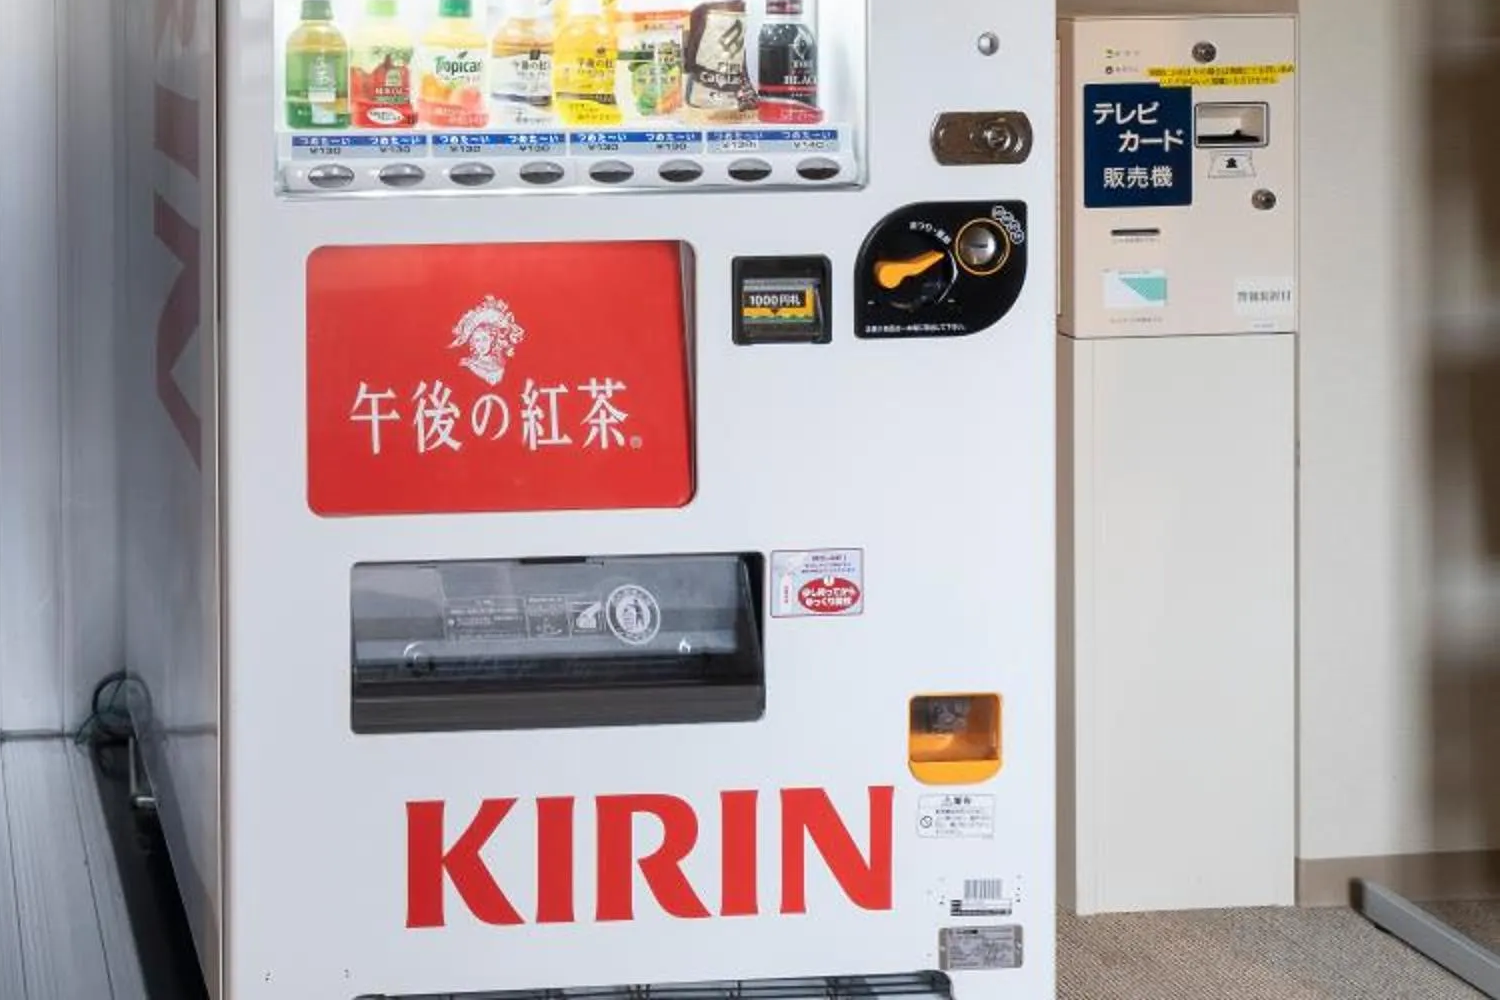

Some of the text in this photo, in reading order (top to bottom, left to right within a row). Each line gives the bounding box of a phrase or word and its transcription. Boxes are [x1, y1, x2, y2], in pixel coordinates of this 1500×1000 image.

[1093, 102, 1160, 125] テレビ
[1118, 129, 1184, 153] カード
[1103, 165, 1174, 189] 販売機
[350, 377, 630, 455] 午後の紅茶
[405, 785, 895, 929] KIRIN
